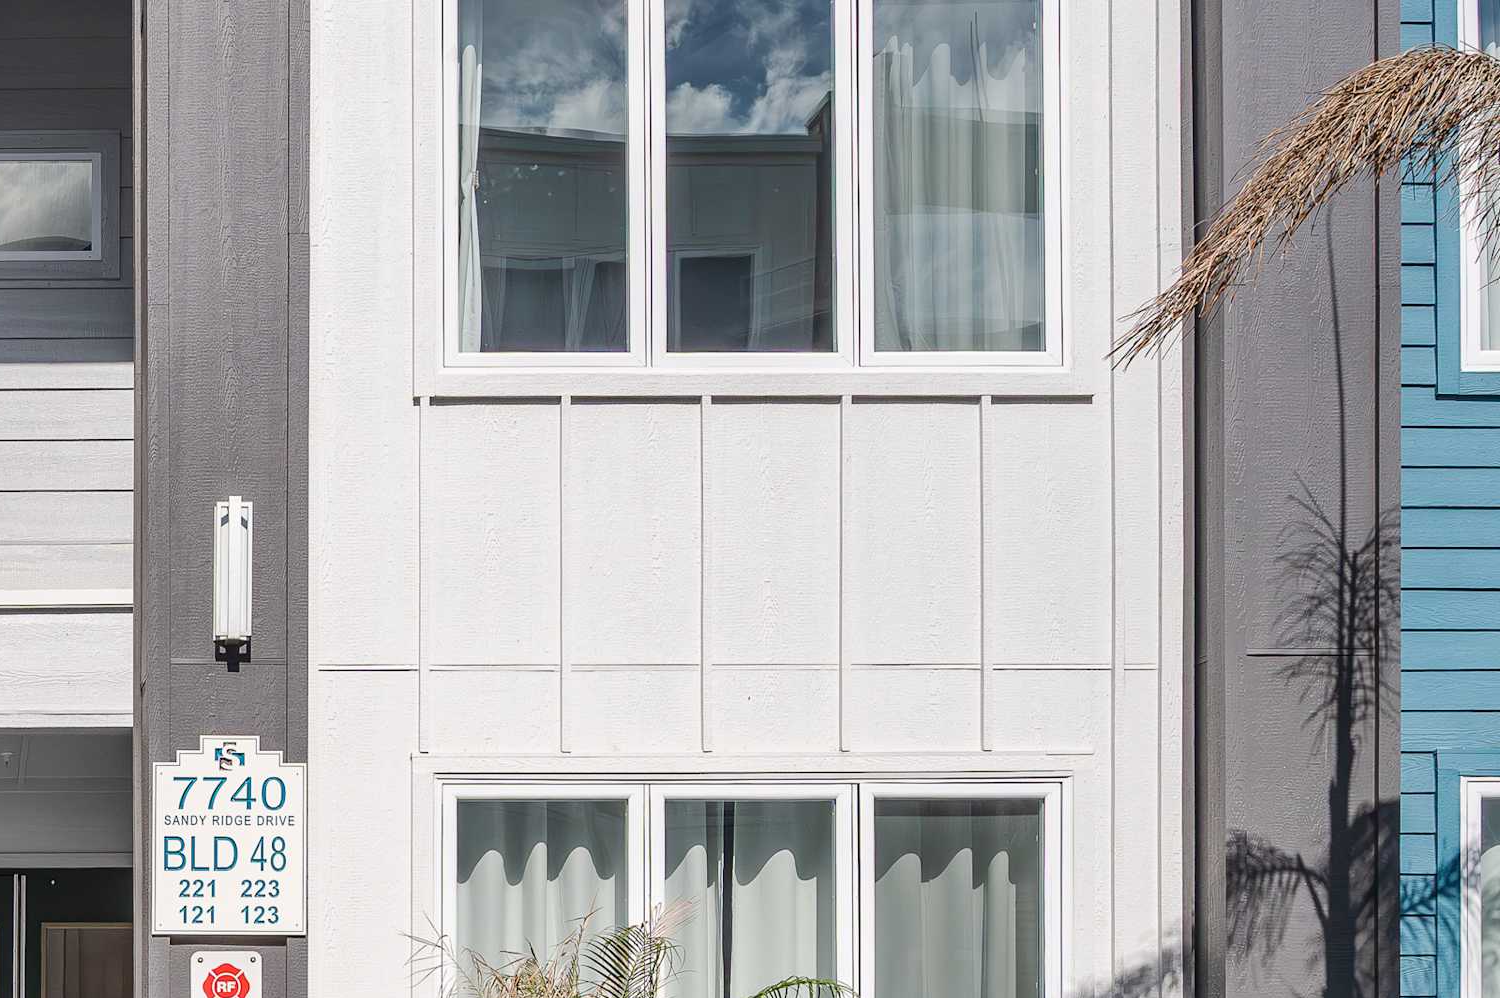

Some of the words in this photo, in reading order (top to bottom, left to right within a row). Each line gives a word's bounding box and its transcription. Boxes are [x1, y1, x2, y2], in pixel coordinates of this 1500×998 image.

[173, 777, 286, 810] 7740
[164, 815, 207, 826] SANDY
[212, 815, 252, 826] RIDGE
[257, 815, 295, 826] DRIVE
[164, 836, 238, 872] BLD
[251, 836, 287, 872] 48
[179, 879, 217, 897] 221
[241, 879, 280, 897] 223
[179, 906, 216, 924] 121
[241, 906, 280, 924] 123
[216, 981, 237, 993] RF
